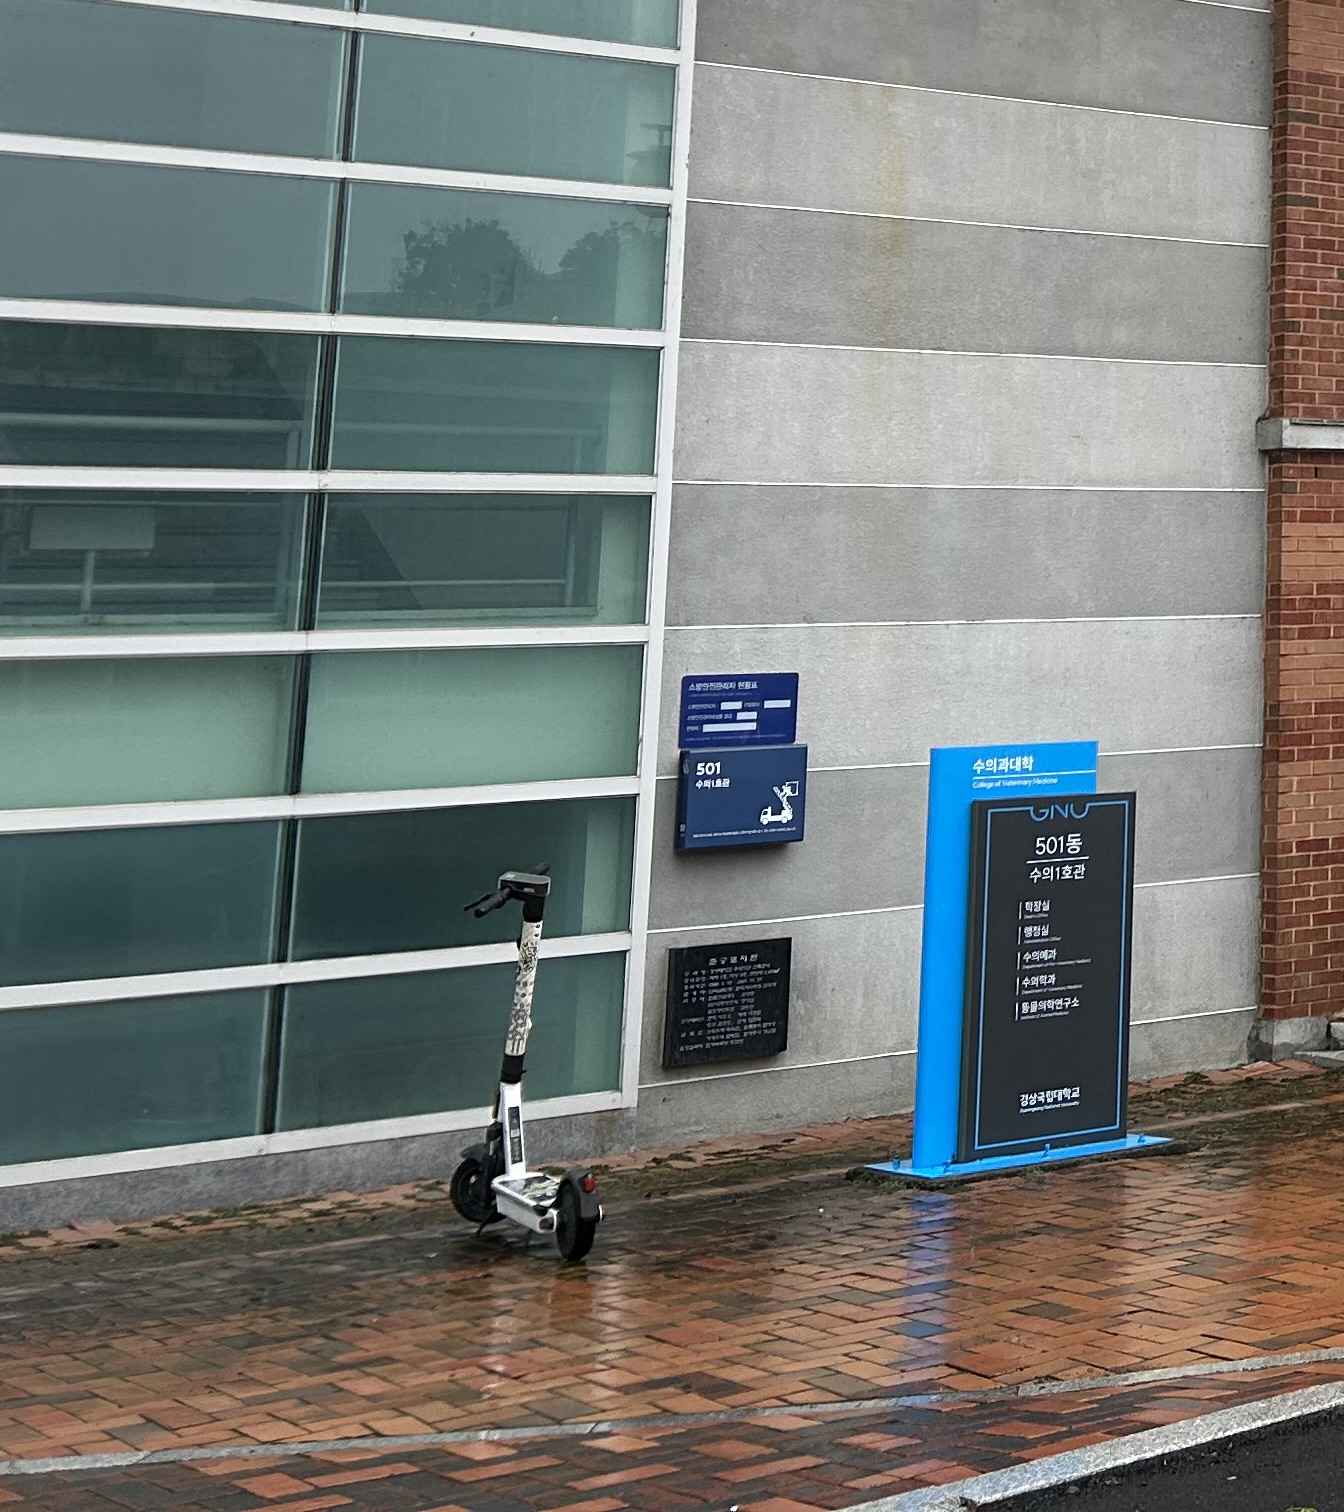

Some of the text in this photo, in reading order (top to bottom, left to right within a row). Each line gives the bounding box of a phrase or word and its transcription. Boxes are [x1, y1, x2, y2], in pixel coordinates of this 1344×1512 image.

[696, 761, 721, 776] 501
[972, 755, 1034, 774] 수의과대학
[1035, 833, 1083, 856] 501동
[1029, 863, 1086, 884] 수의1호관
[1025, 899, 1050, 912] 학장실
[1024, 924, 1049, 938] 행정실
[1023, 948, 1057, 963] 수의예과
[1022, 973, 1056, 988] 수의학과
[1021, 996, 1080, 1014] 동물의학연구소
[1020, 1087, 1080, 1107] 경상국립대학교
